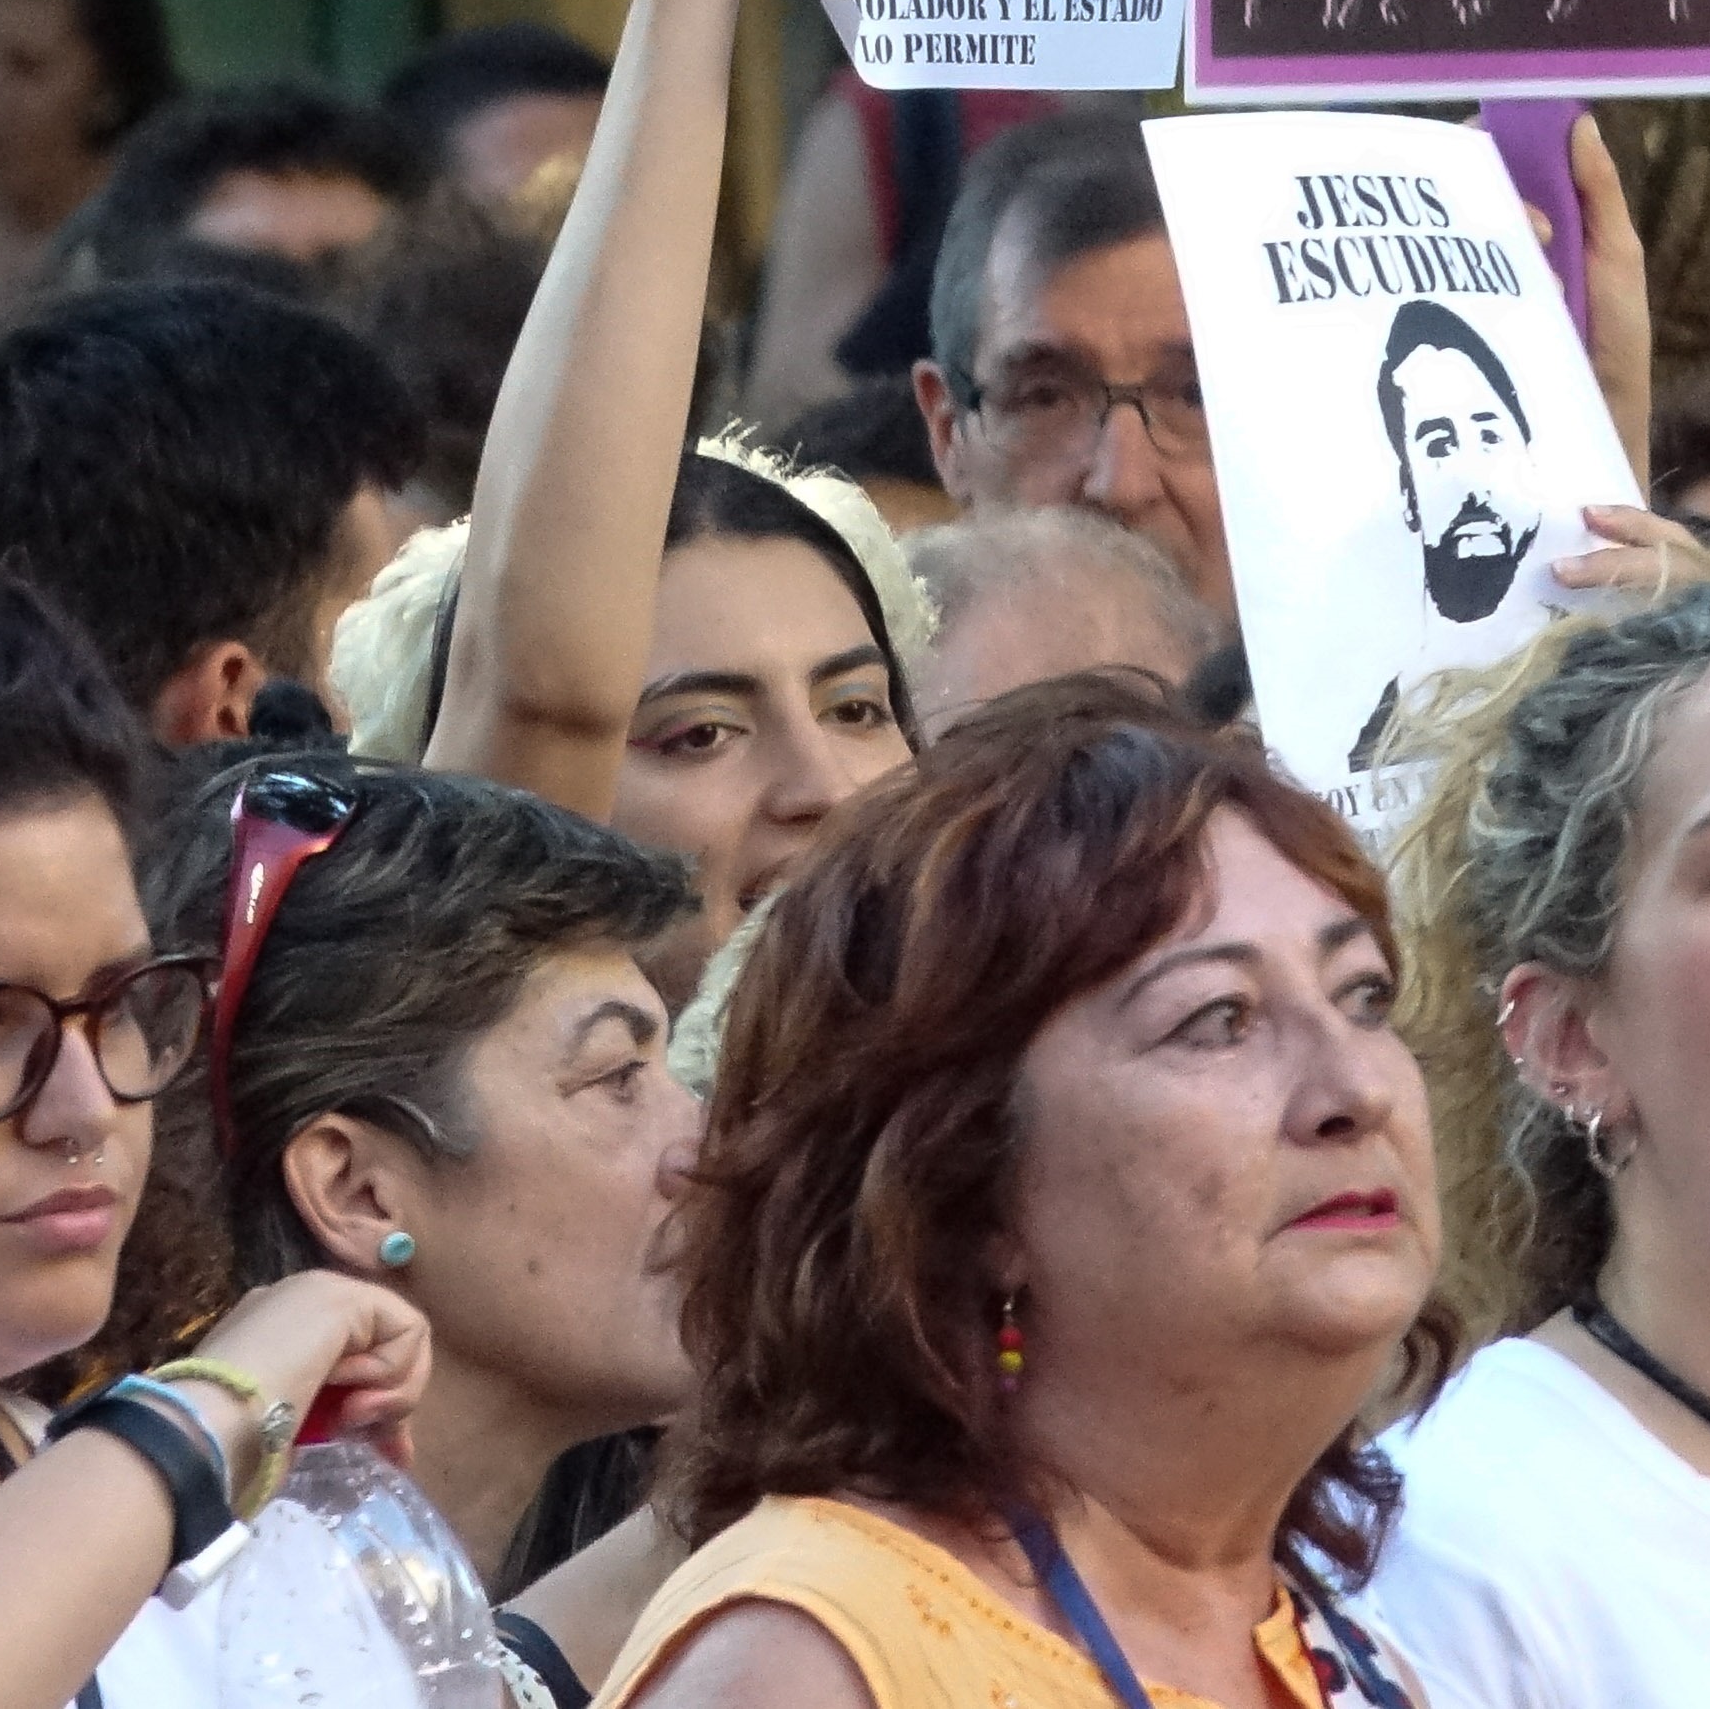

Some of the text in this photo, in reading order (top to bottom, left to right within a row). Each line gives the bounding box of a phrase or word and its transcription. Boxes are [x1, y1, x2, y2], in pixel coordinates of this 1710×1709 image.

[860, 34, 1036, 66] LO PERMITE
[1294, 175, 1450, 229] JESUS
[1263, 235, 1521, 304] ESCUDERO
